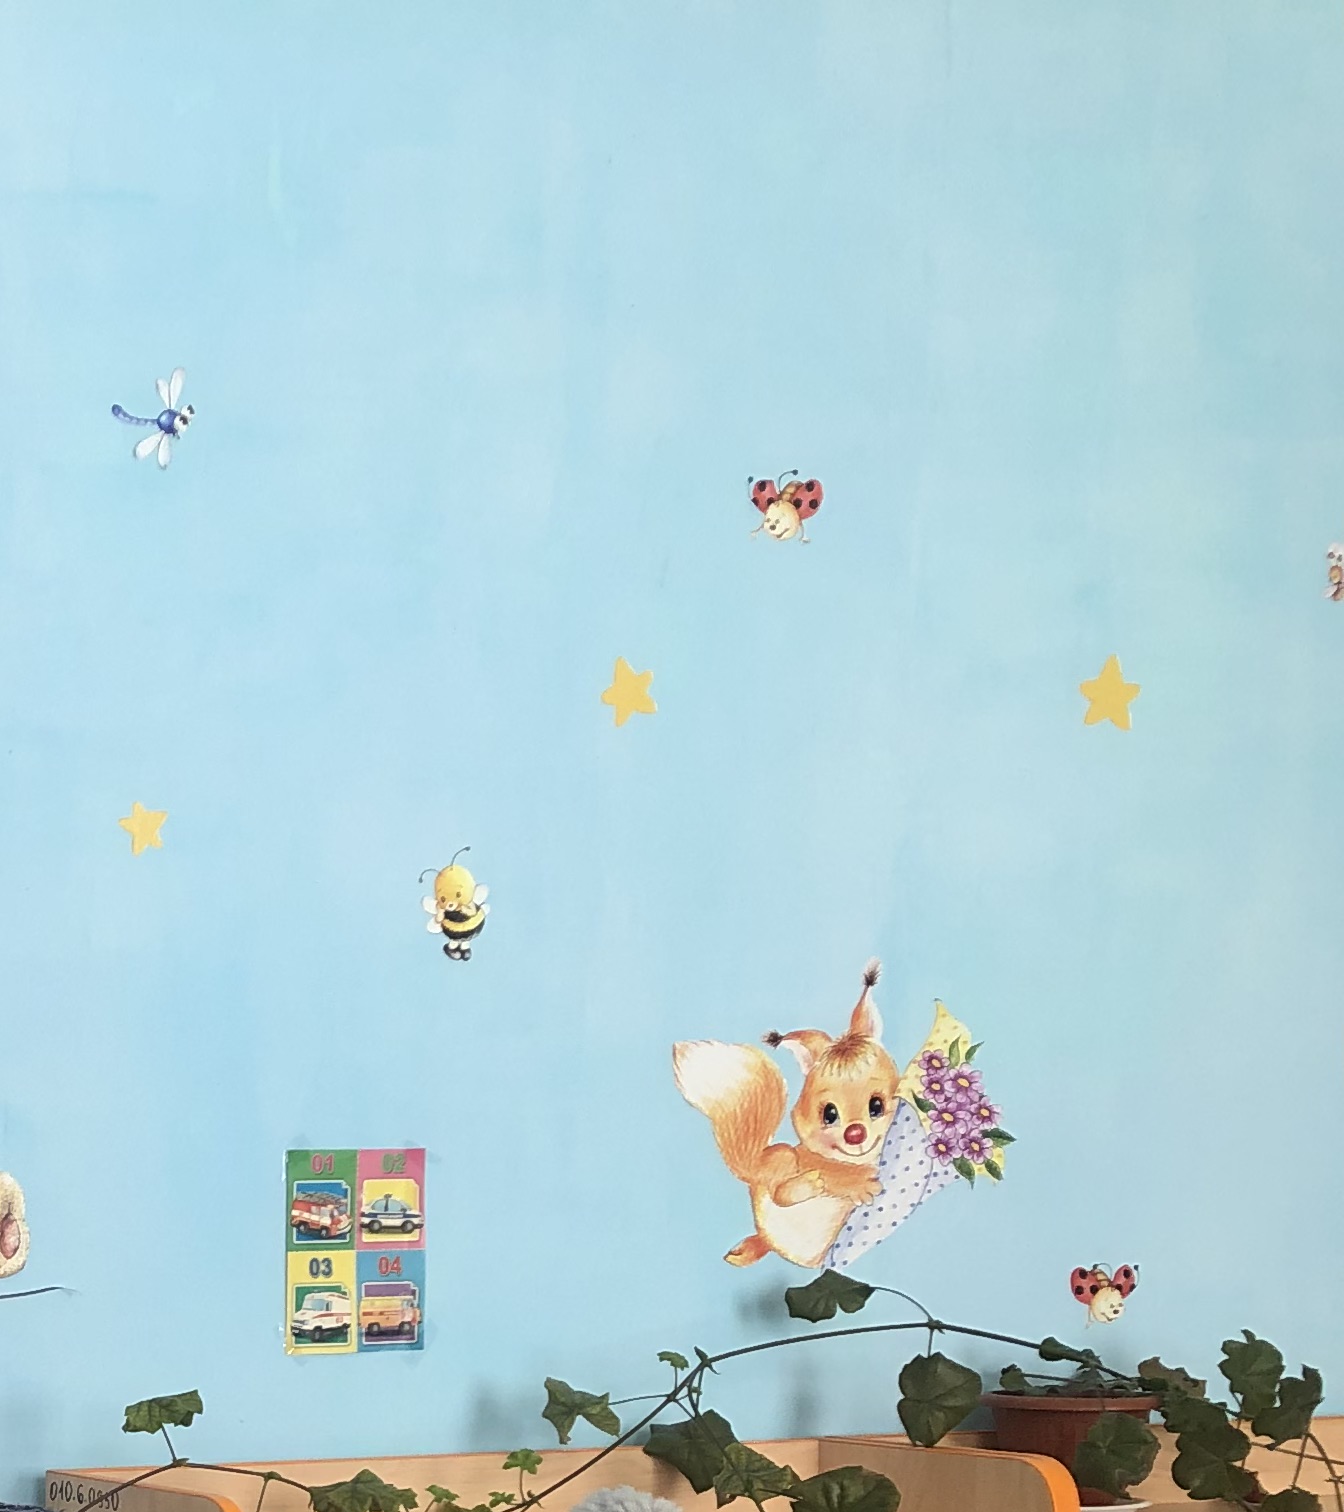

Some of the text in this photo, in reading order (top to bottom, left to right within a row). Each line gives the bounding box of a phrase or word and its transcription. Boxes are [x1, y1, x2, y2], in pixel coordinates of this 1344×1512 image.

[312, 1154, 334, 1174] 01
[310, 1257, 333, 1278] 03
[378, 1256, 402, 1277] 04
